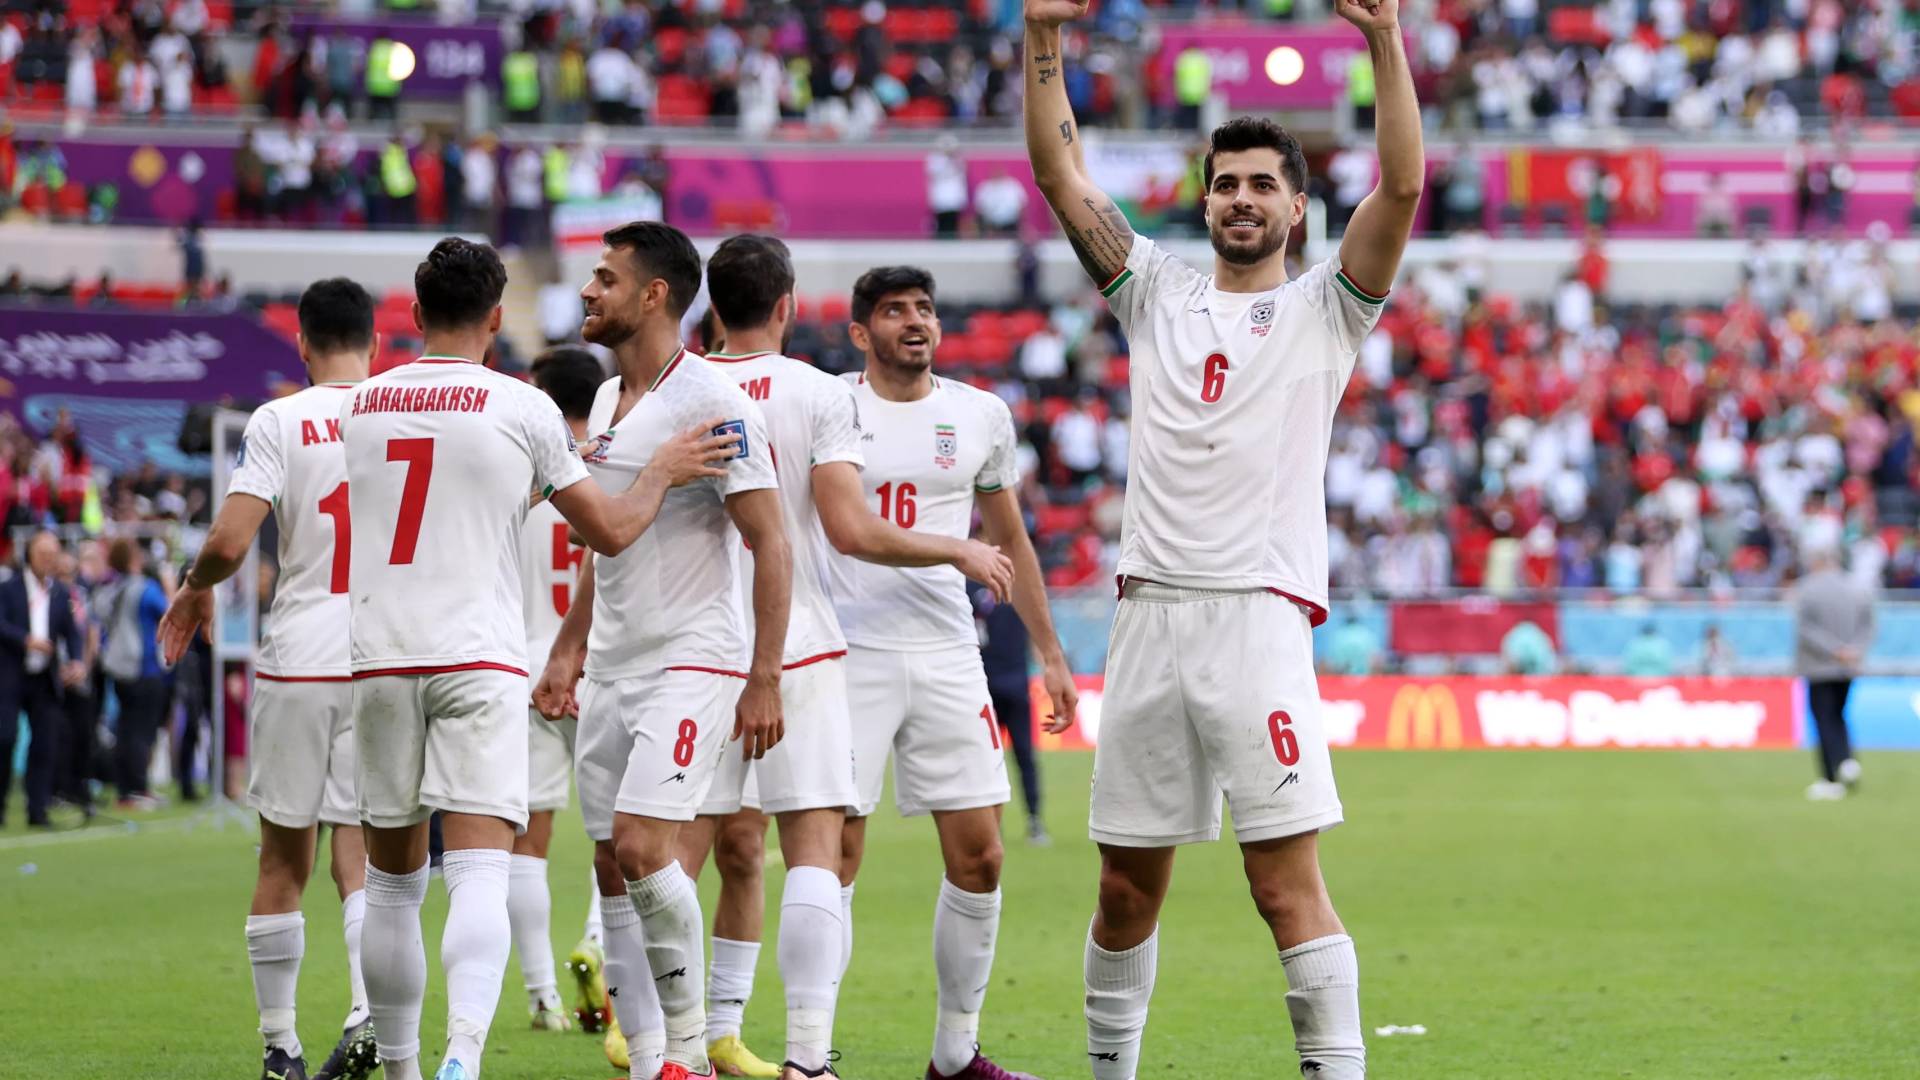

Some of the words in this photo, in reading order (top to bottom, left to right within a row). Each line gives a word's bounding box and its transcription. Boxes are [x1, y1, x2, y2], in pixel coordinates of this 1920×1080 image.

[352, 386, 489, 416] A.JAHANBAKHSH
[1201, 354, 1229, 403] 6
[386, 438, 434, 564] 7
[876, 481, 917, 529] 16
[318, 481, 351, 594] 1
[552, 523, 585, 619] 5
[979, 704, 999, 750] 1
[1268, 710, 1300, 766] 6
[1476, 690, 1567, 746] We
[1569, 687, 1766, 746] Deliver
[674, 719, 697, 767] 8
